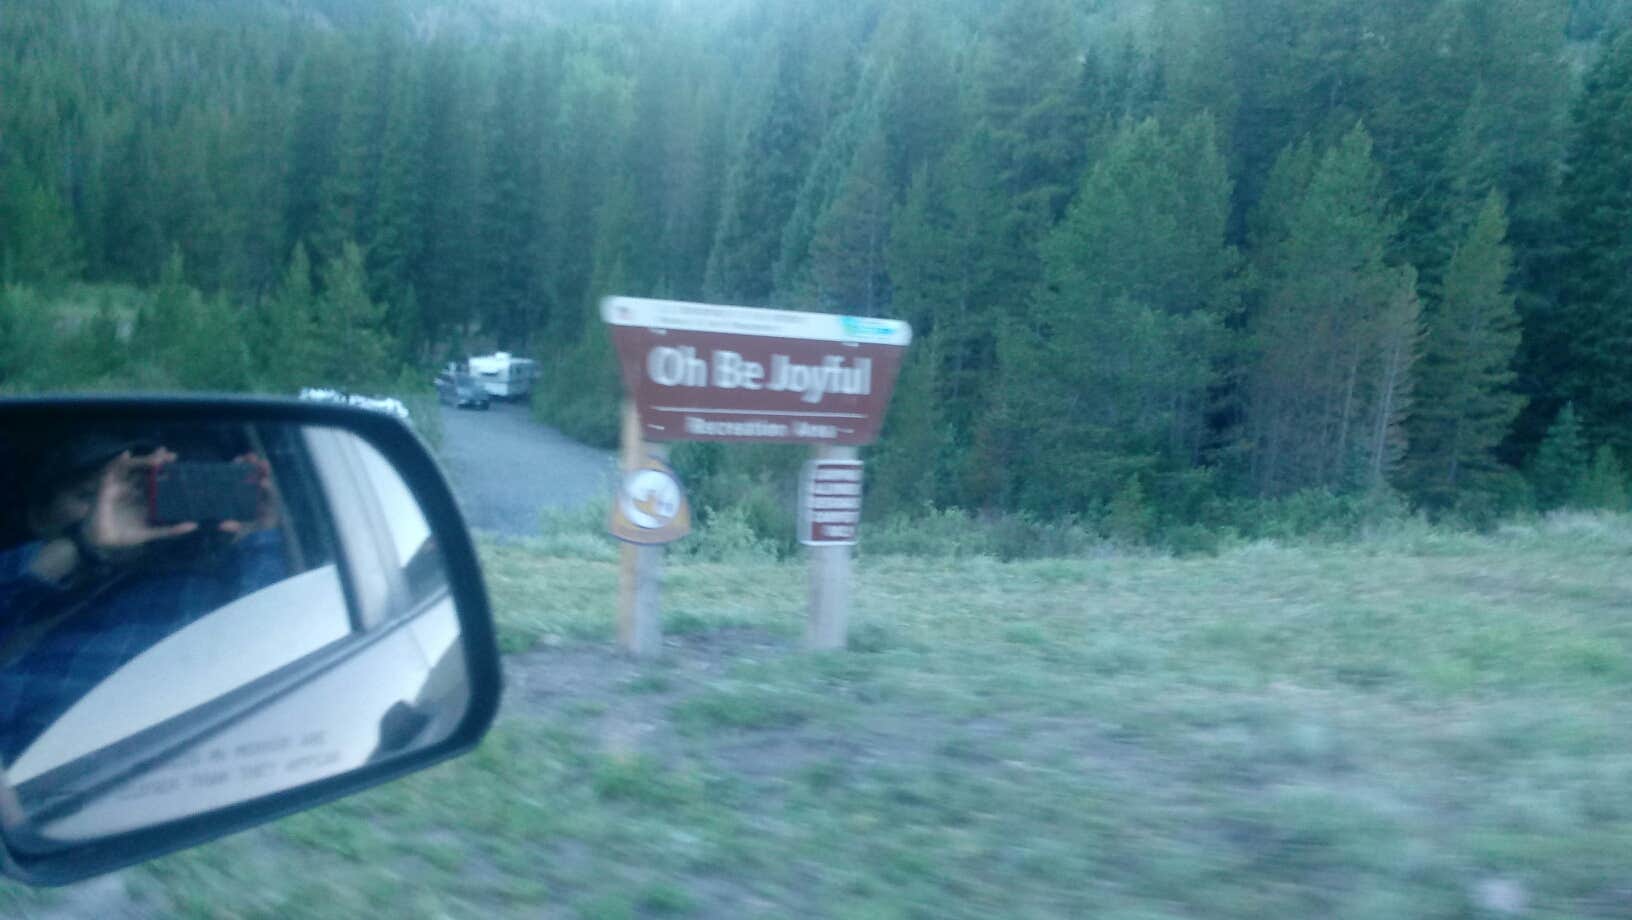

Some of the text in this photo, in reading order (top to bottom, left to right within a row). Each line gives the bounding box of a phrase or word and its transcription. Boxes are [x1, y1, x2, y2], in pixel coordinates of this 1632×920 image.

[647, 345, 871, 403] Oh Be Joyful
